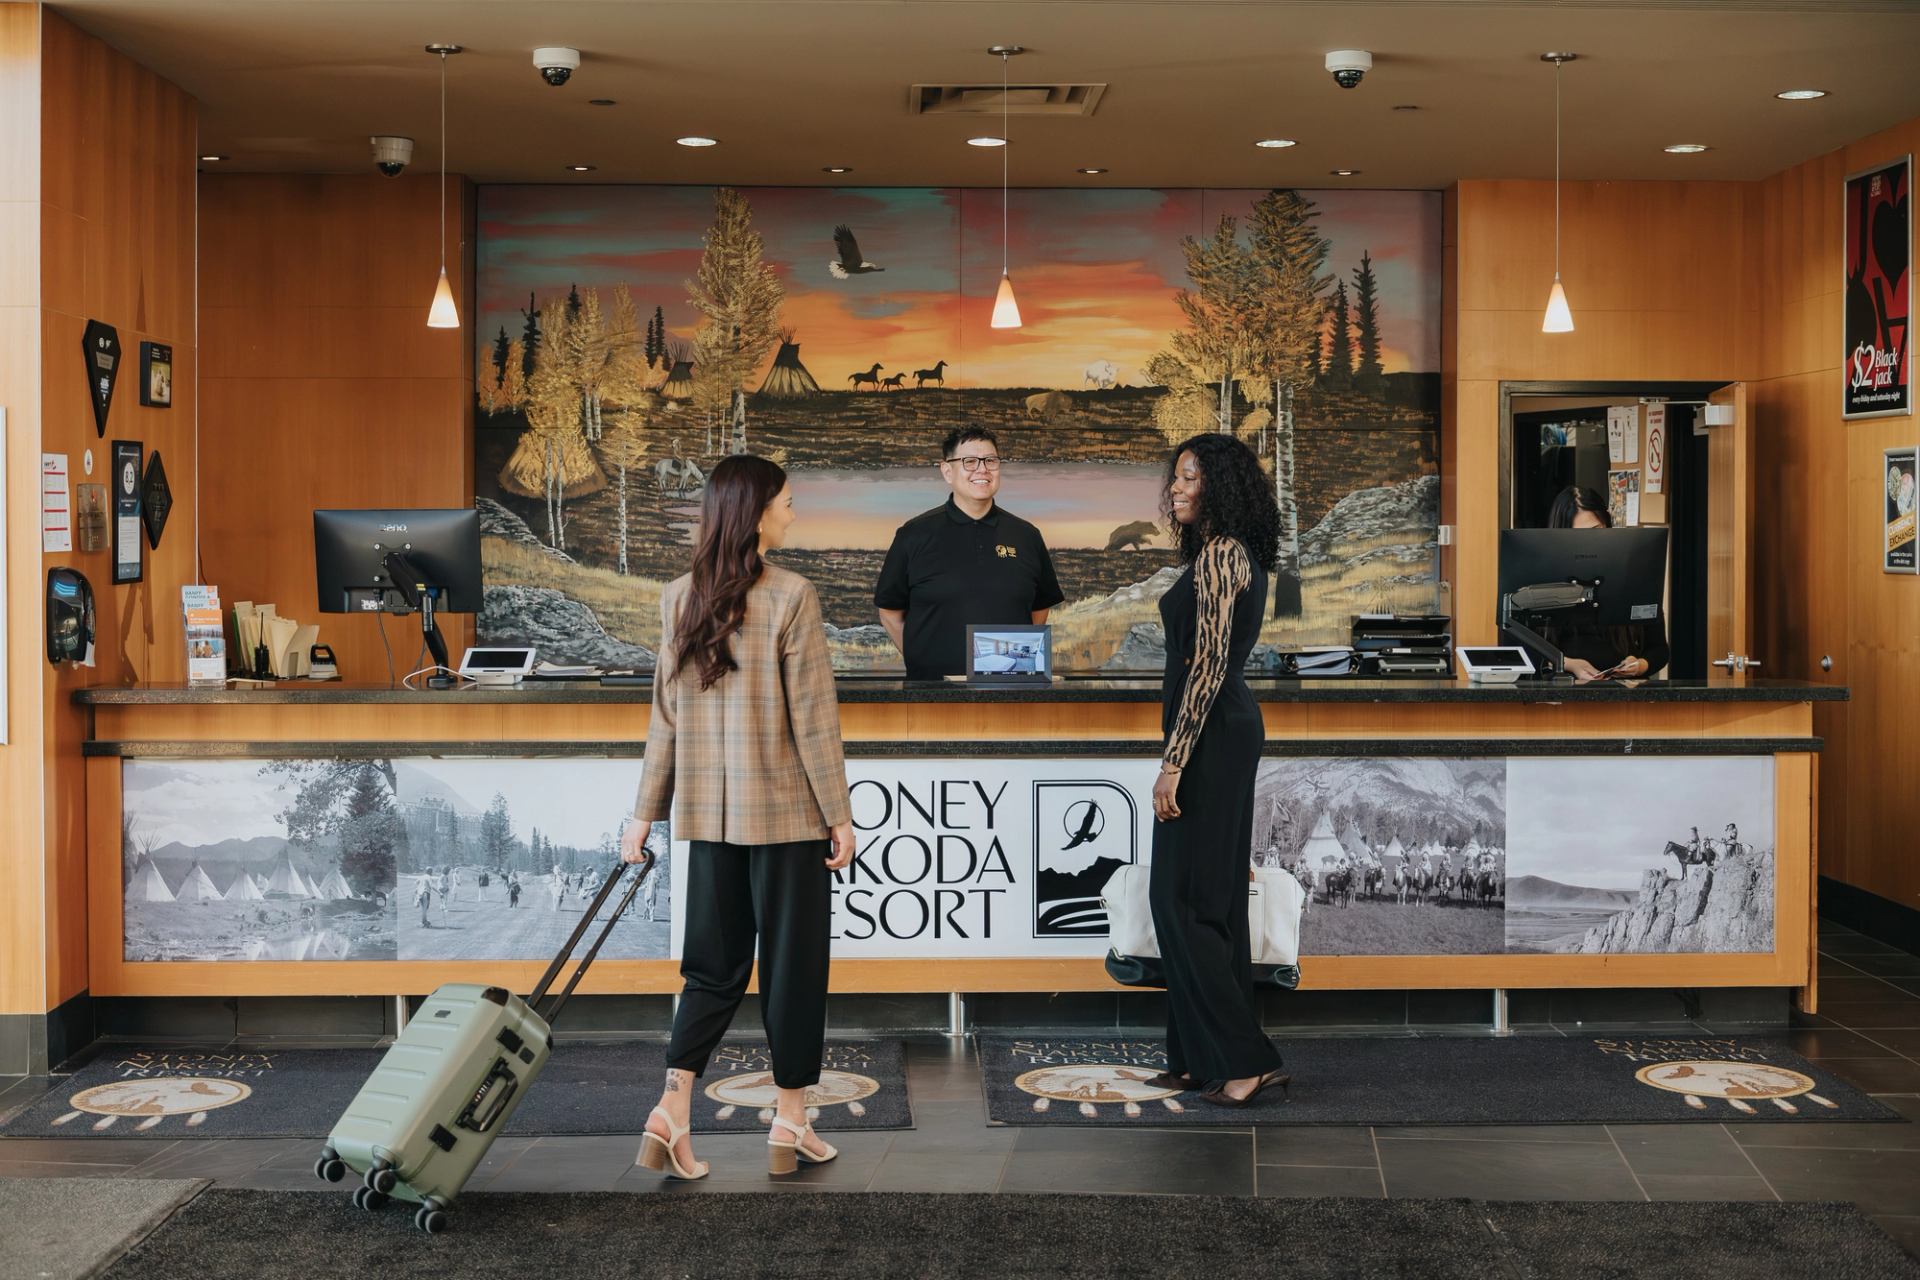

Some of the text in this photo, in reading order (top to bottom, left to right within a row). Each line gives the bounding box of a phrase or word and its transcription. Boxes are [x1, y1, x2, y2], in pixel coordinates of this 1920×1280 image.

[1852, 341, 1898, 393] $2 Black
[1873, 367, 1893, 391] jack
[1889, 526, 1915, 547] EXCHANGE
[849, 780, 1008, 830] ONEY
[831, 834, 1016, 885] KODA
